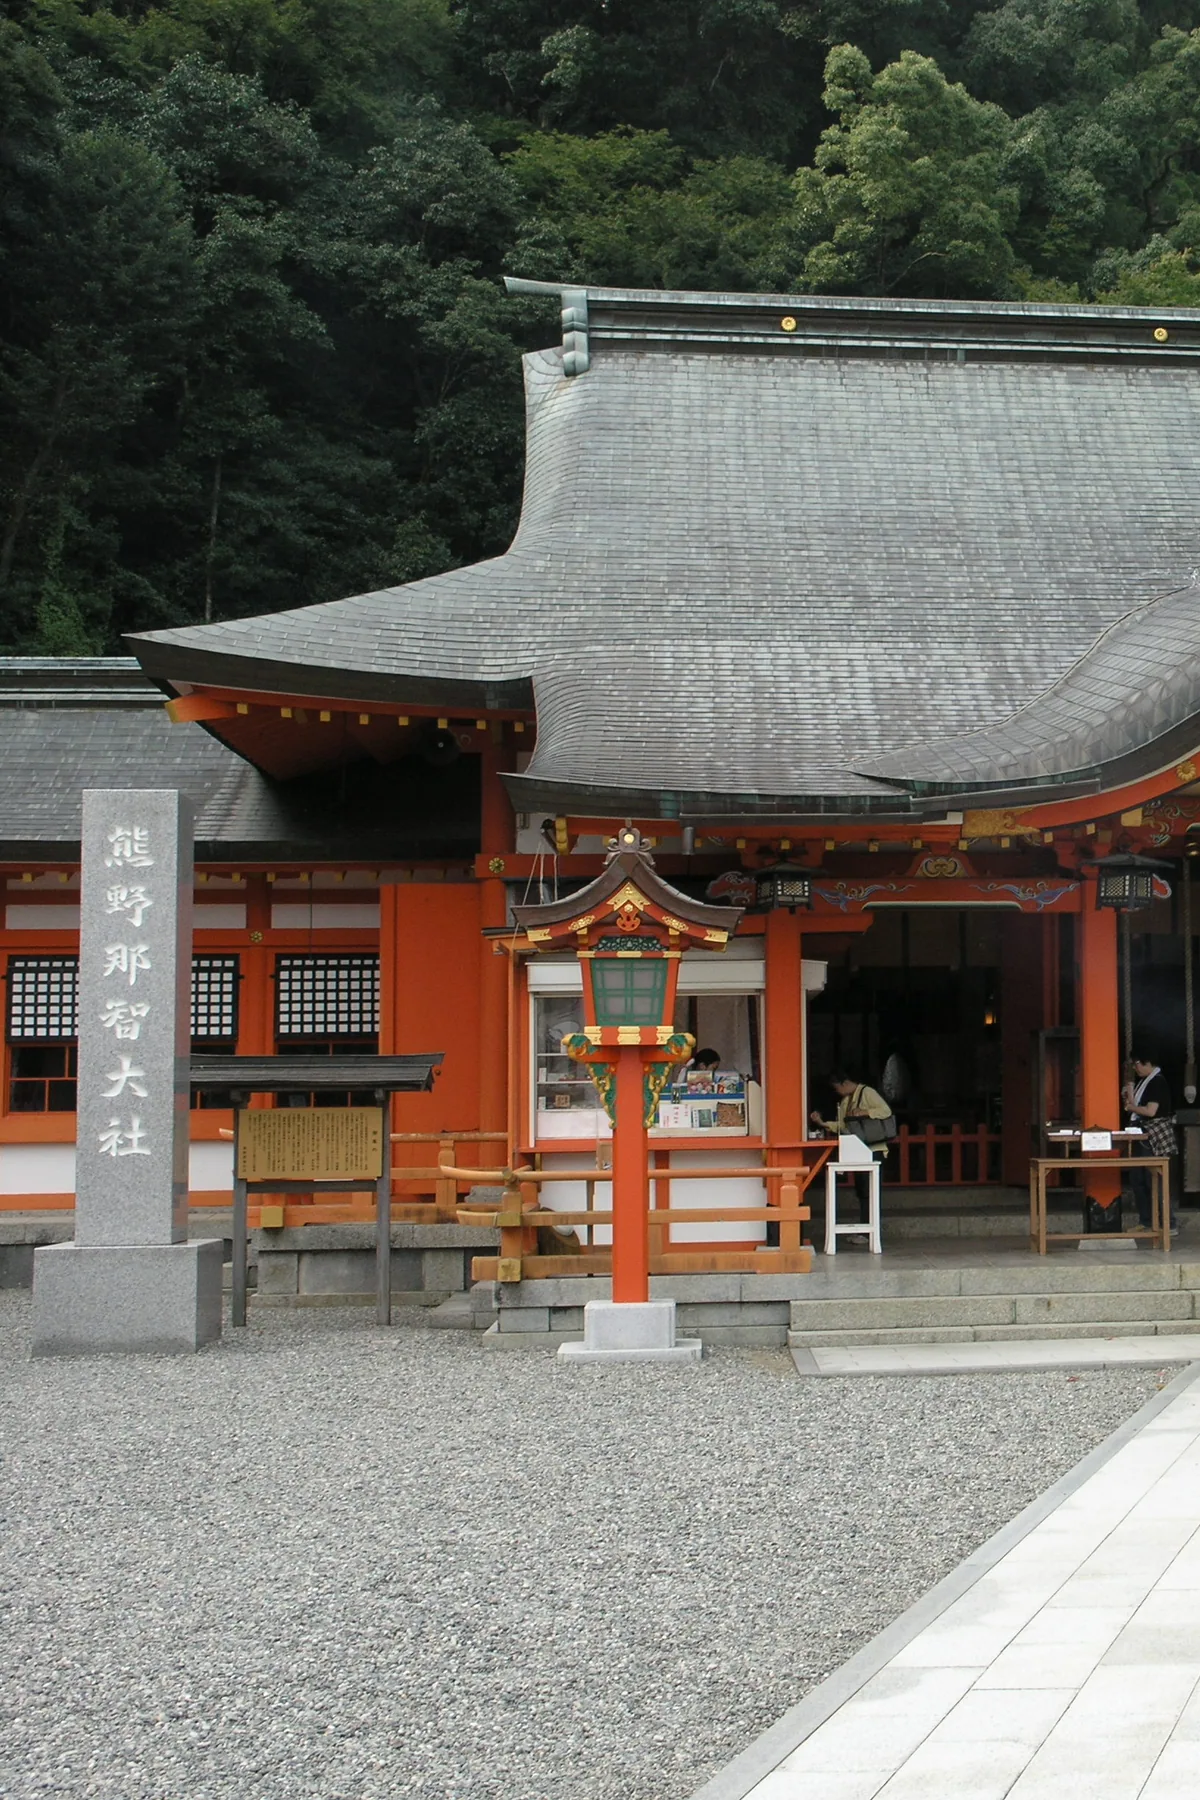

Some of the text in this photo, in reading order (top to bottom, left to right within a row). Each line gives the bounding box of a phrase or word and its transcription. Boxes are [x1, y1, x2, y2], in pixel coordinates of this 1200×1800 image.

[99, 825, 155, 1157] 熊野那智大社
